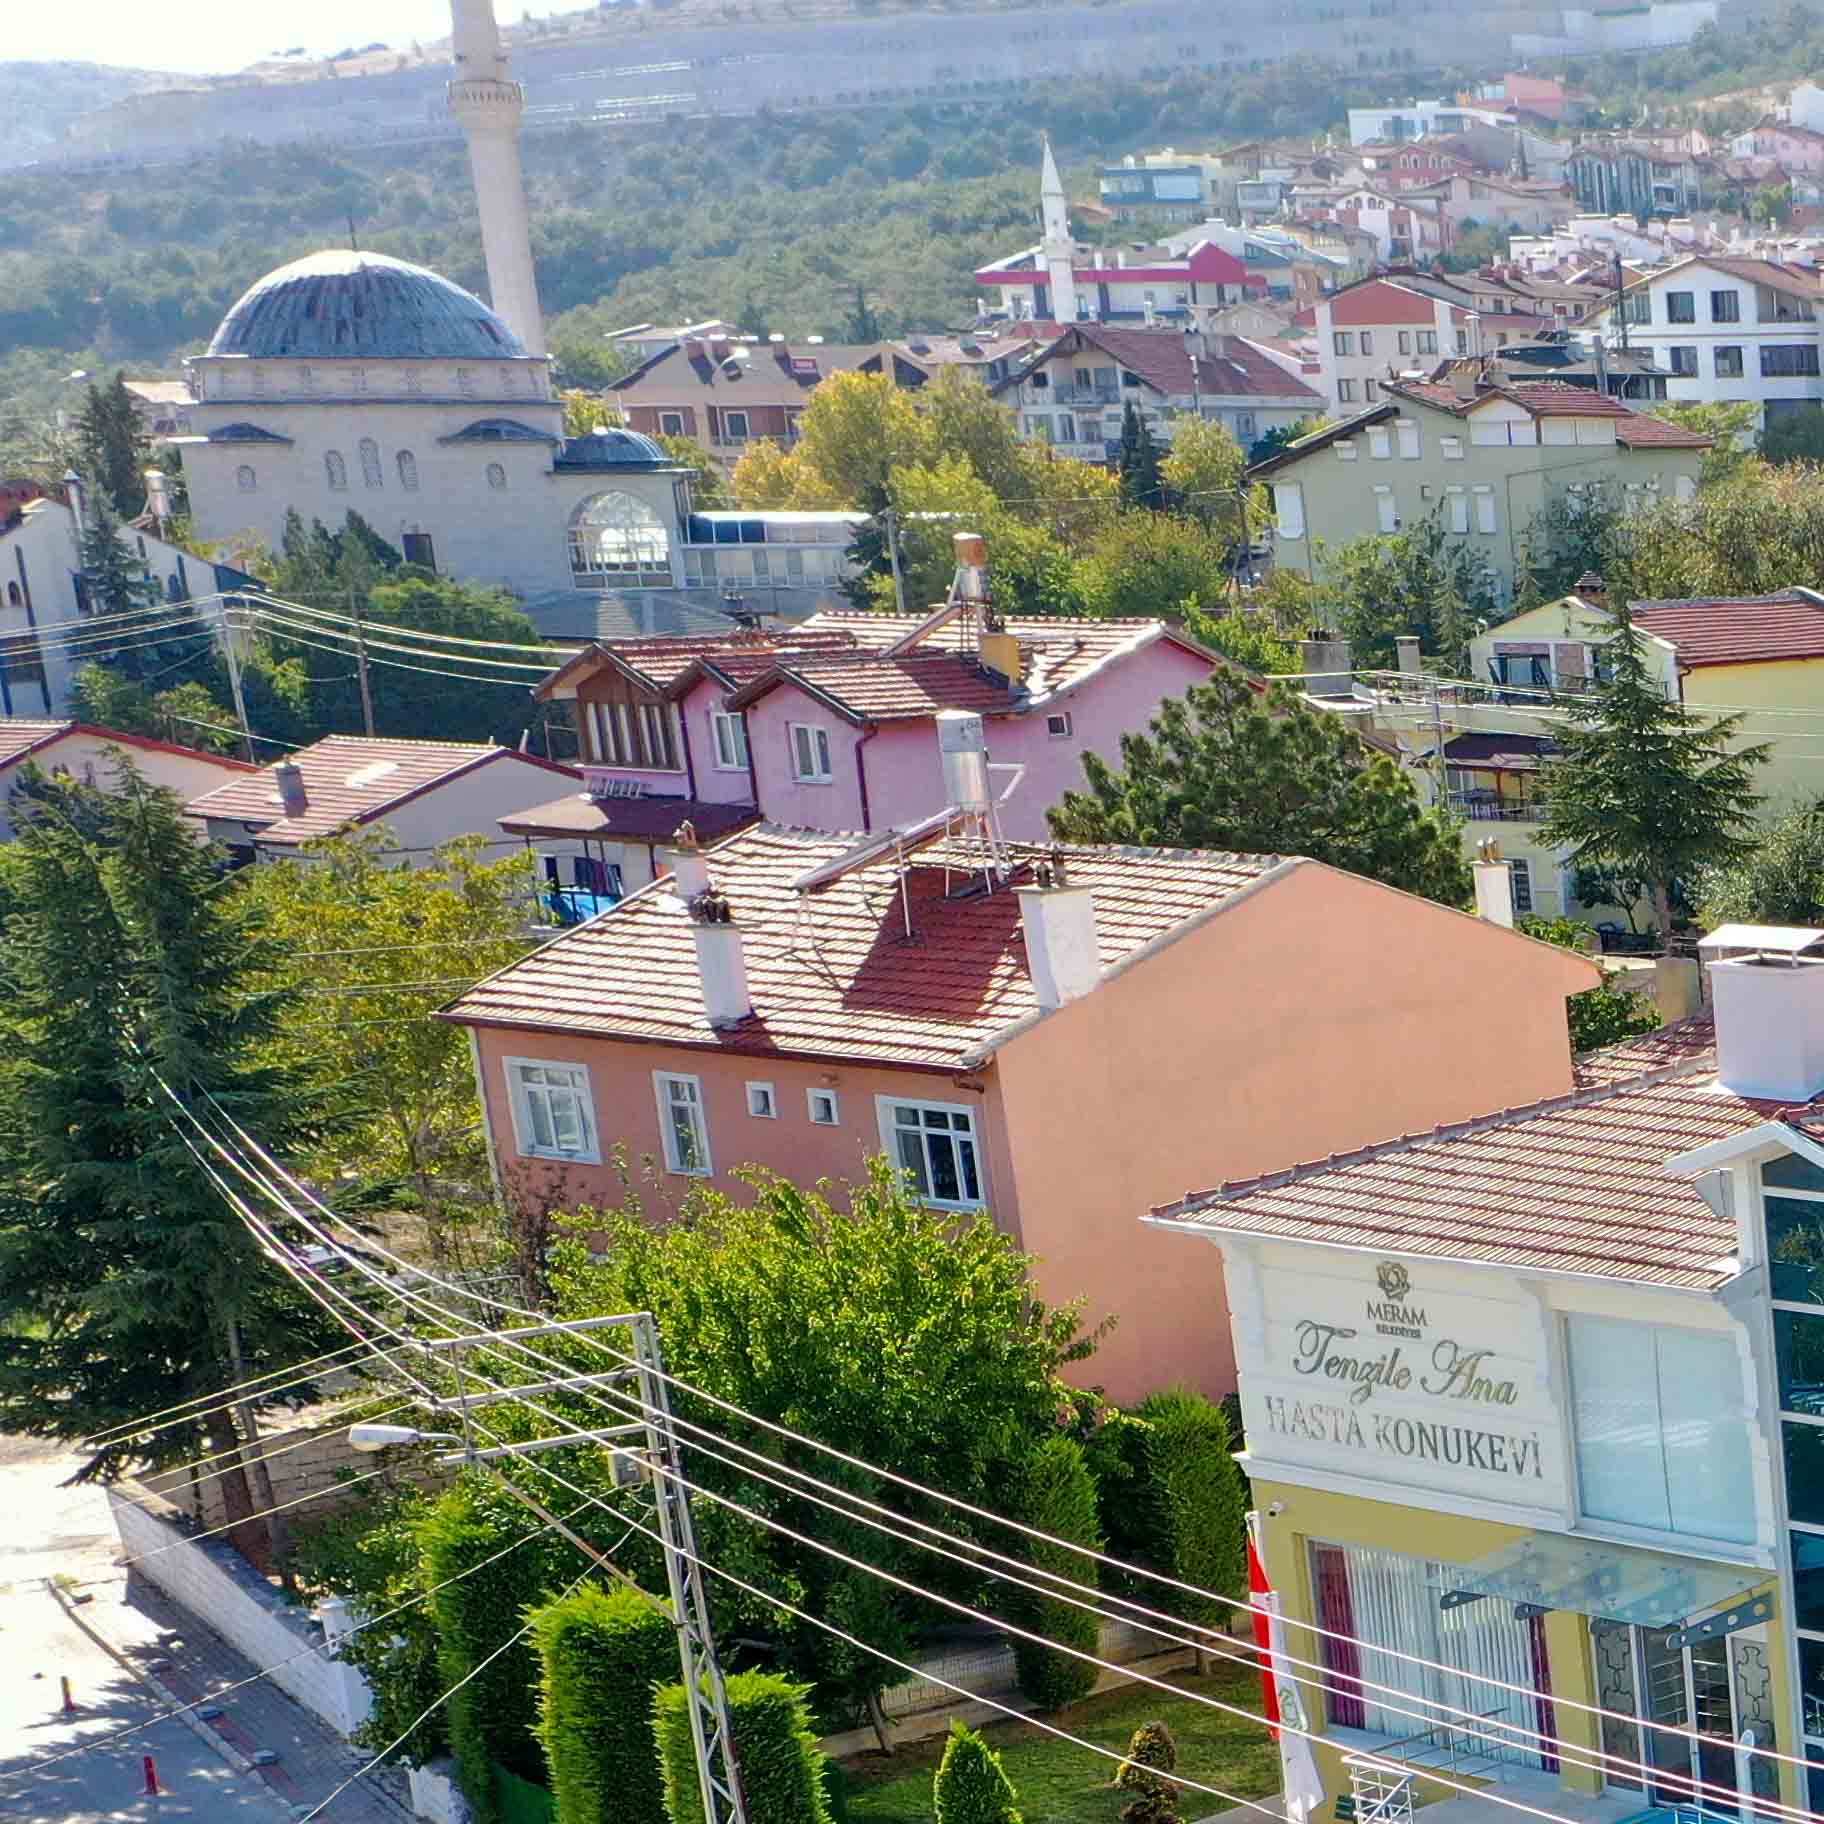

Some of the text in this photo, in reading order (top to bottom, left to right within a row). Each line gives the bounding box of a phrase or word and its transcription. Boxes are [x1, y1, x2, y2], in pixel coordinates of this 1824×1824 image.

[1367, 1301, 1428, 1326] MERAM
[1294, 1320, 1518, 1406] Tenzile Ana
[1264, 1395, 1544, 1479] HASTA KONUKEVİ
